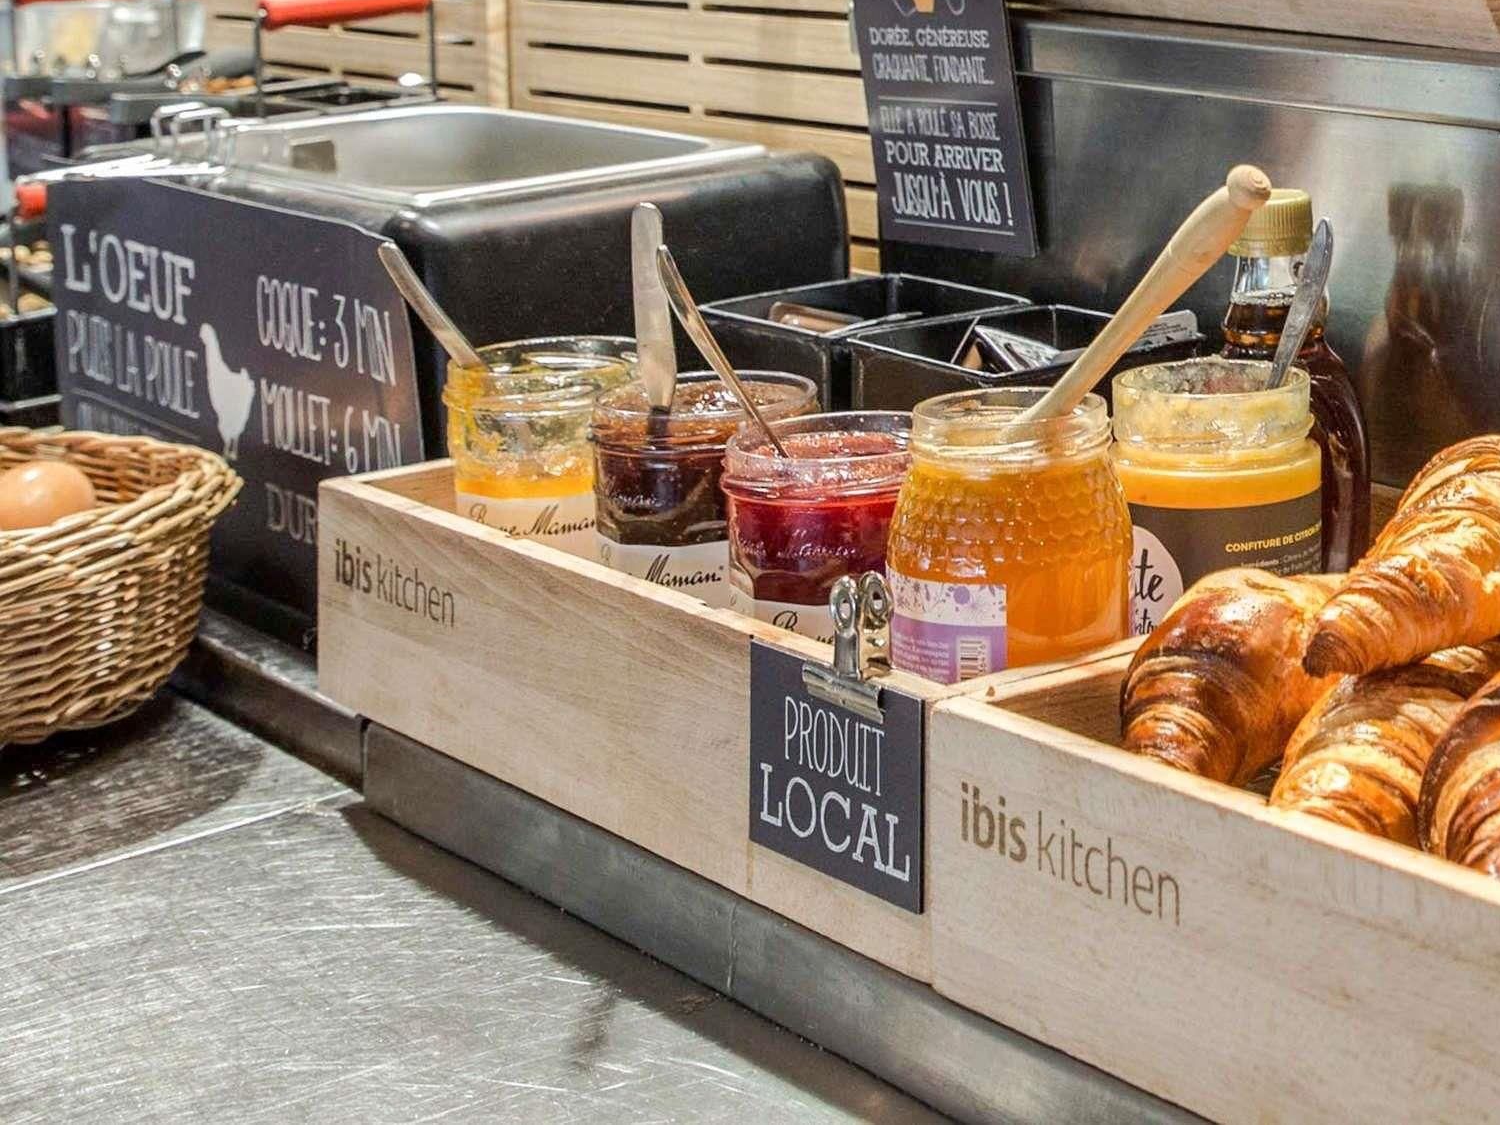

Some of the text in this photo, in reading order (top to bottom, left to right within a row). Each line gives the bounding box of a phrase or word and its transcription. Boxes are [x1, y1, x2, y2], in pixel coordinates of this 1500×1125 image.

[884, 140, 1006, 174] POUR ARRIVER
[333, 293, 350, 369] 3
[335, 538, 455, 628] ibis kitchen
[1225, 538, 1282, 553] CONFITURE
[1282, 535, 1294, 545] DE
[784, 695, 885, 797] PRODUIT
[759, 761, 910, 883] LOCAL
[961, 781, 1180, 927] ibis kitchen
